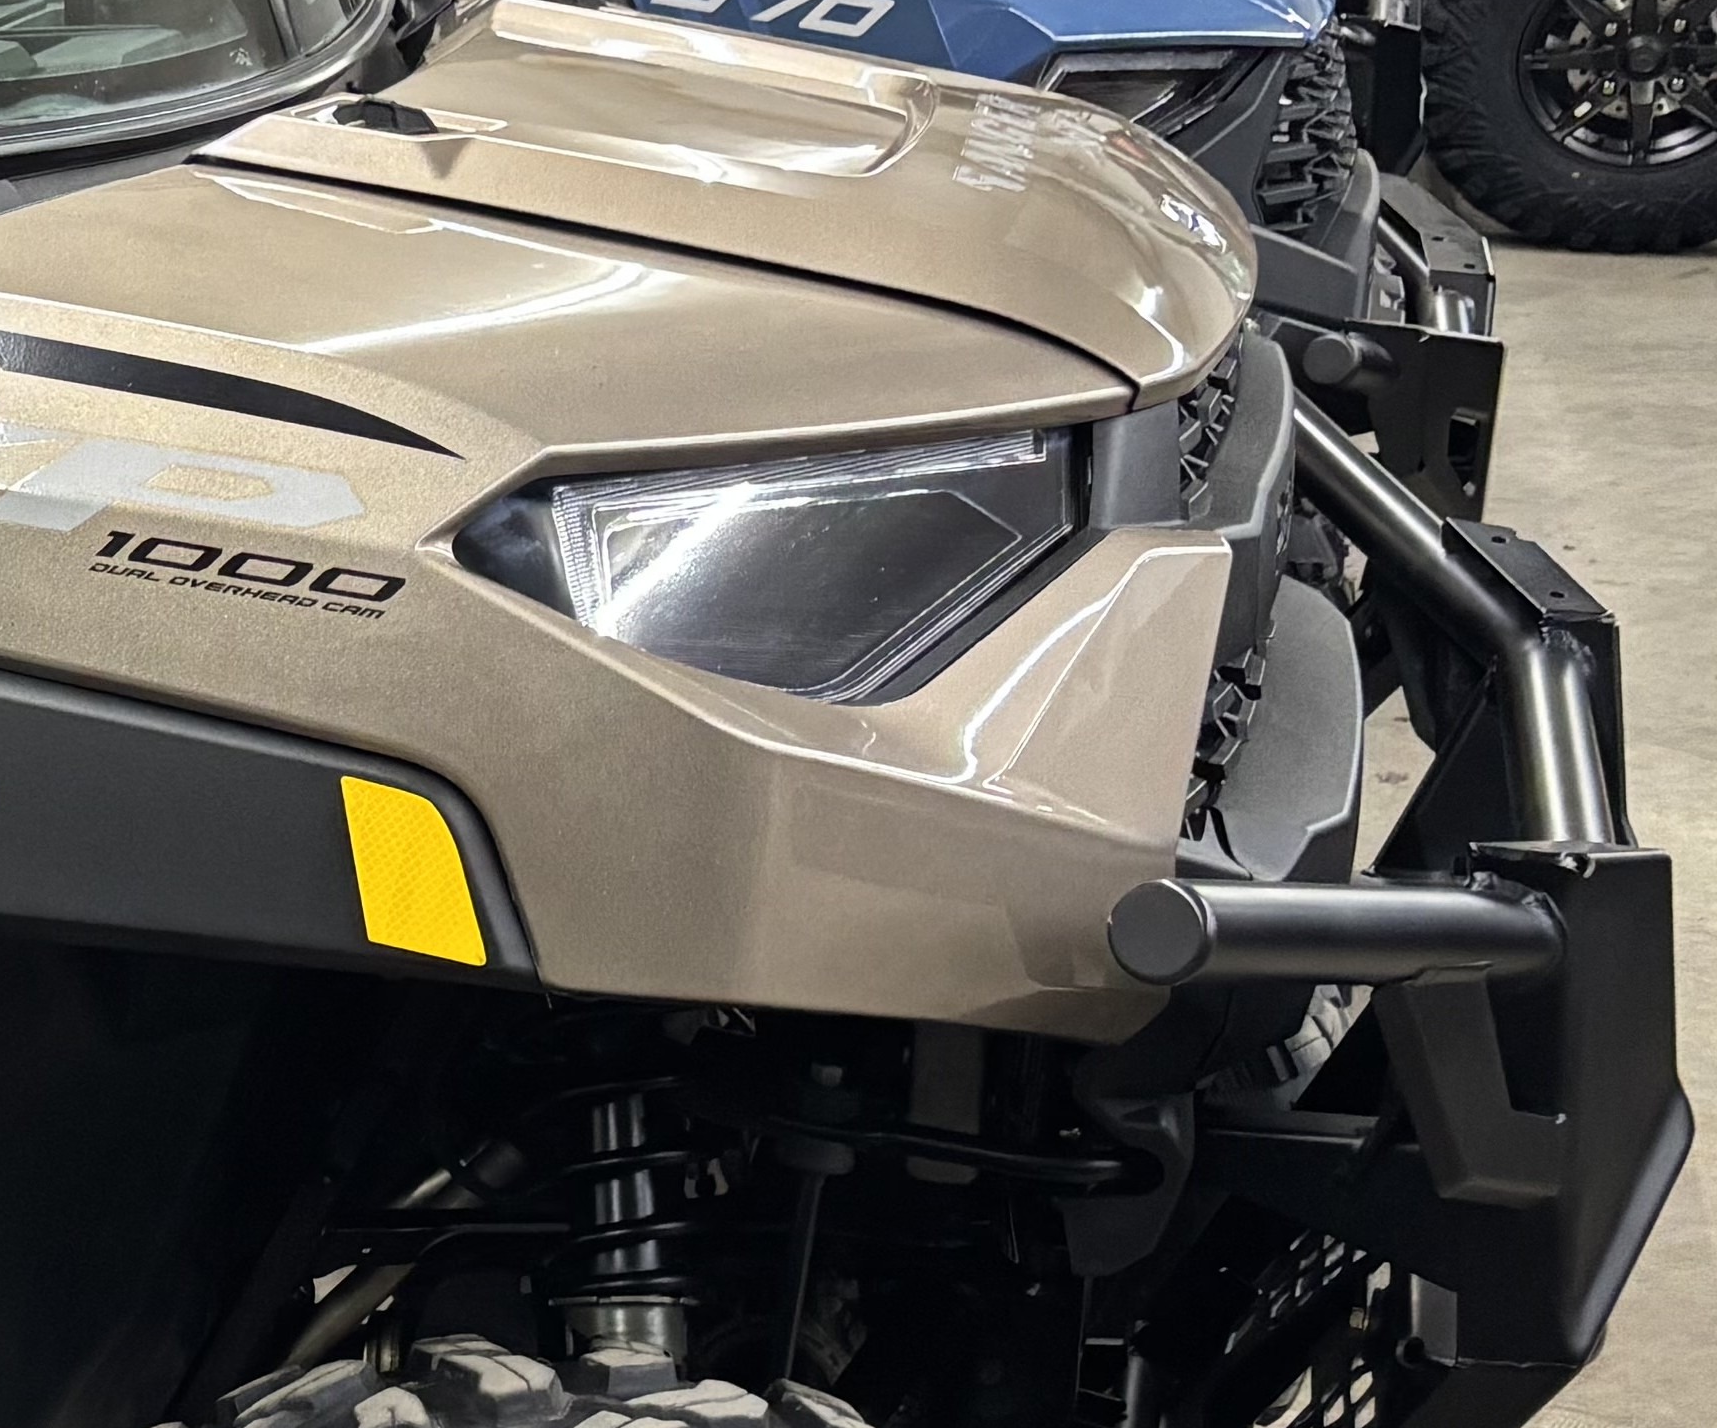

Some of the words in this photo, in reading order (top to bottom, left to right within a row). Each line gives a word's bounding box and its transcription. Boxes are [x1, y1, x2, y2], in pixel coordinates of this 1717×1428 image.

[88, 562, 162, 583] DUAL
[169, 575, 318, 609] OVERHEAD
[321, 600, 387, 621] CAM
[95, 529, 407, 603] 1000
